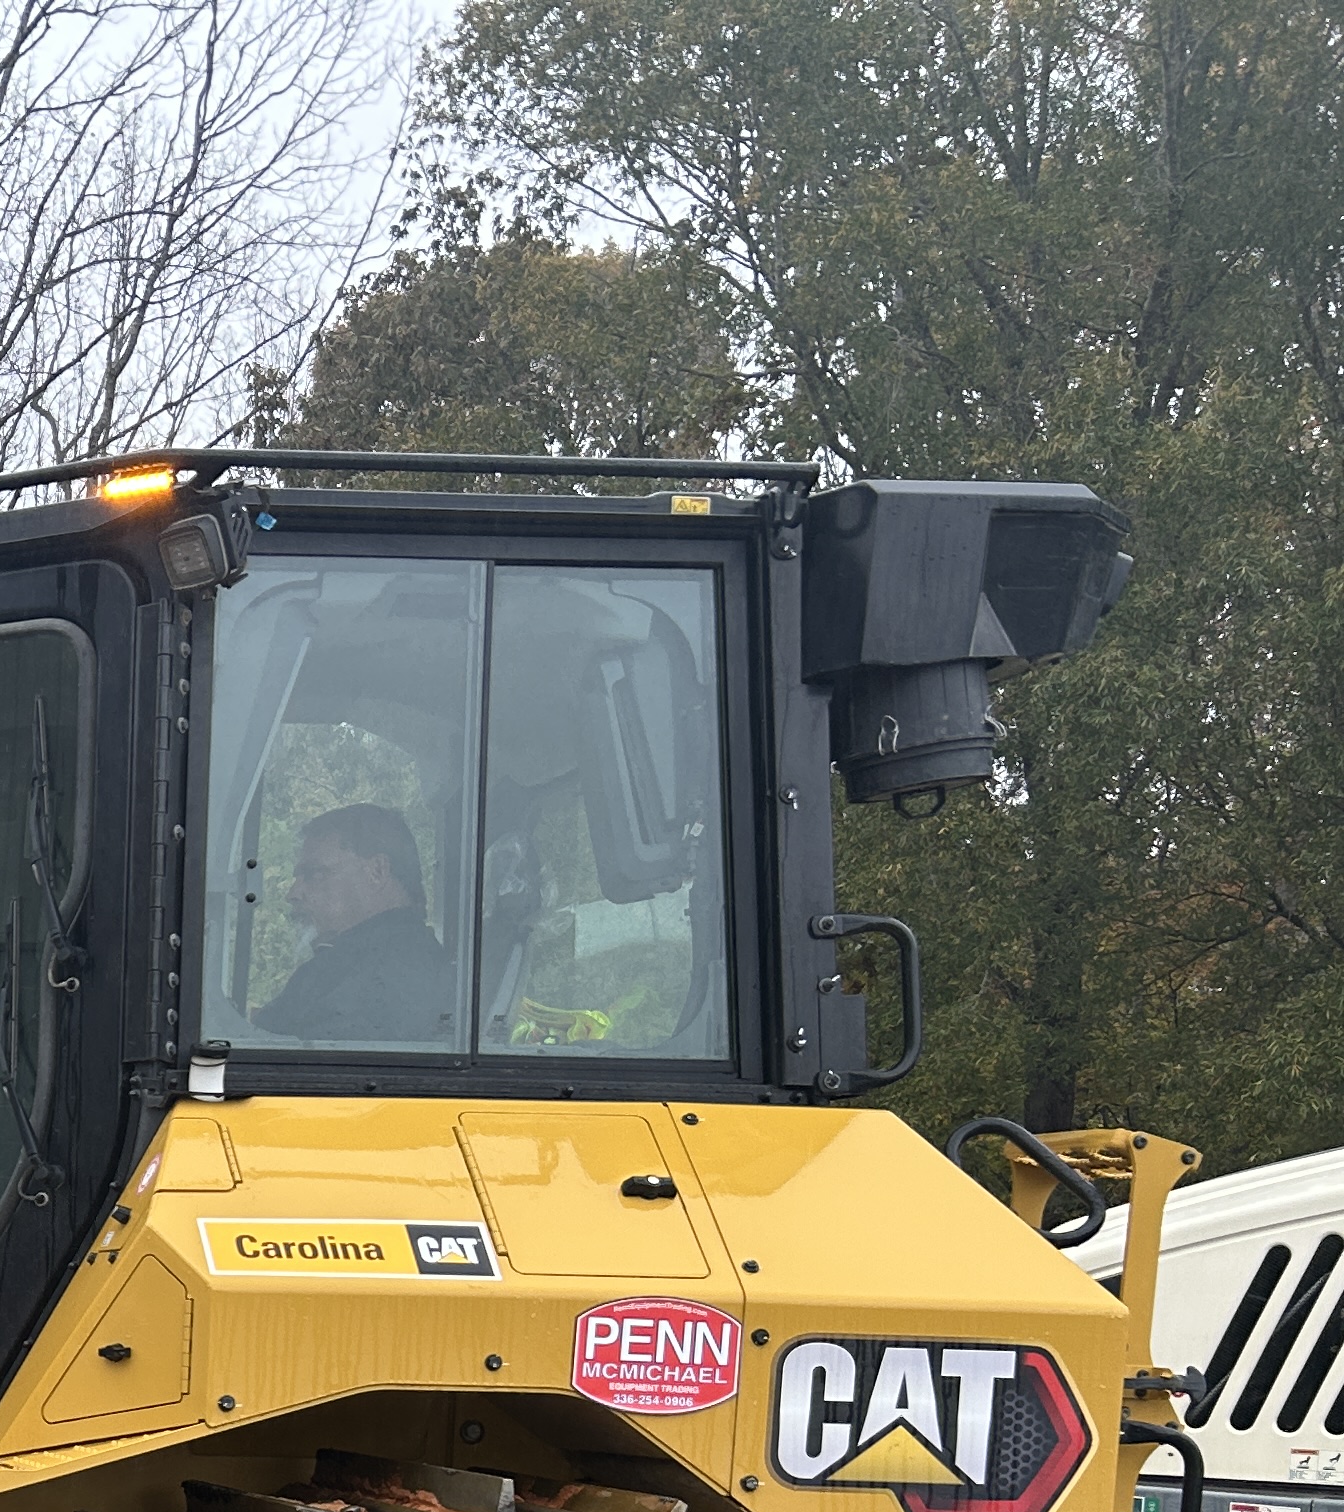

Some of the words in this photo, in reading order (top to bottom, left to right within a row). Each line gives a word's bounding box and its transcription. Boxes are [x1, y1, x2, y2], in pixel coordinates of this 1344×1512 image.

[235, 1233, 386, 1262] Carolina
[416, 1235, 480, 1265] CAT
[584, 1316, 732, 1367] PENN
[581, 1361, 729, 1385] MCMICHAEL
[608, 1382, 660, 1394] EQUIPMENT
[661, 1384, 700, 1395] TRADING
[612, 1393, 694, 1408] 336-254-0906
[777, 1341, 1017, 1485] CAT
